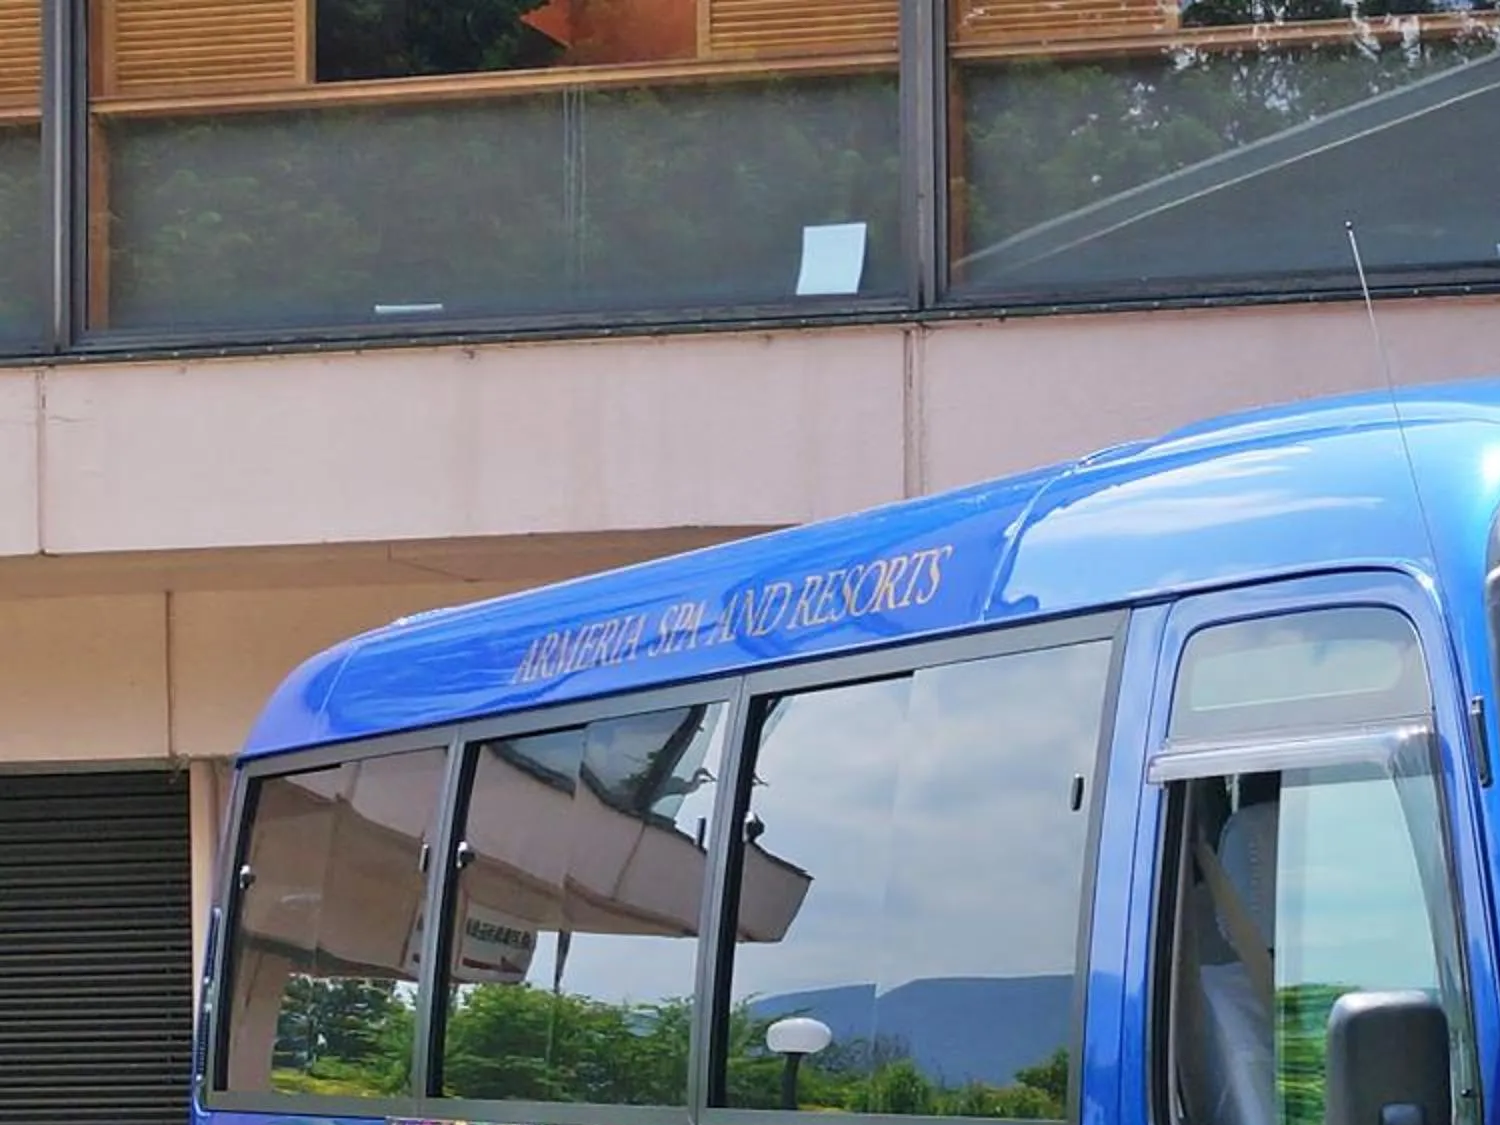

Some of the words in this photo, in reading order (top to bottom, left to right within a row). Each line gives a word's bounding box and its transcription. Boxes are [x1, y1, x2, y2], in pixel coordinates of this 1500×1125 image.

[511, 613, 645, 684] ARMERIA
[648, 602, 706, 657] SPA
[710, 581, 791, 642] AND
[787, 546, 952, 629] RESORTS
